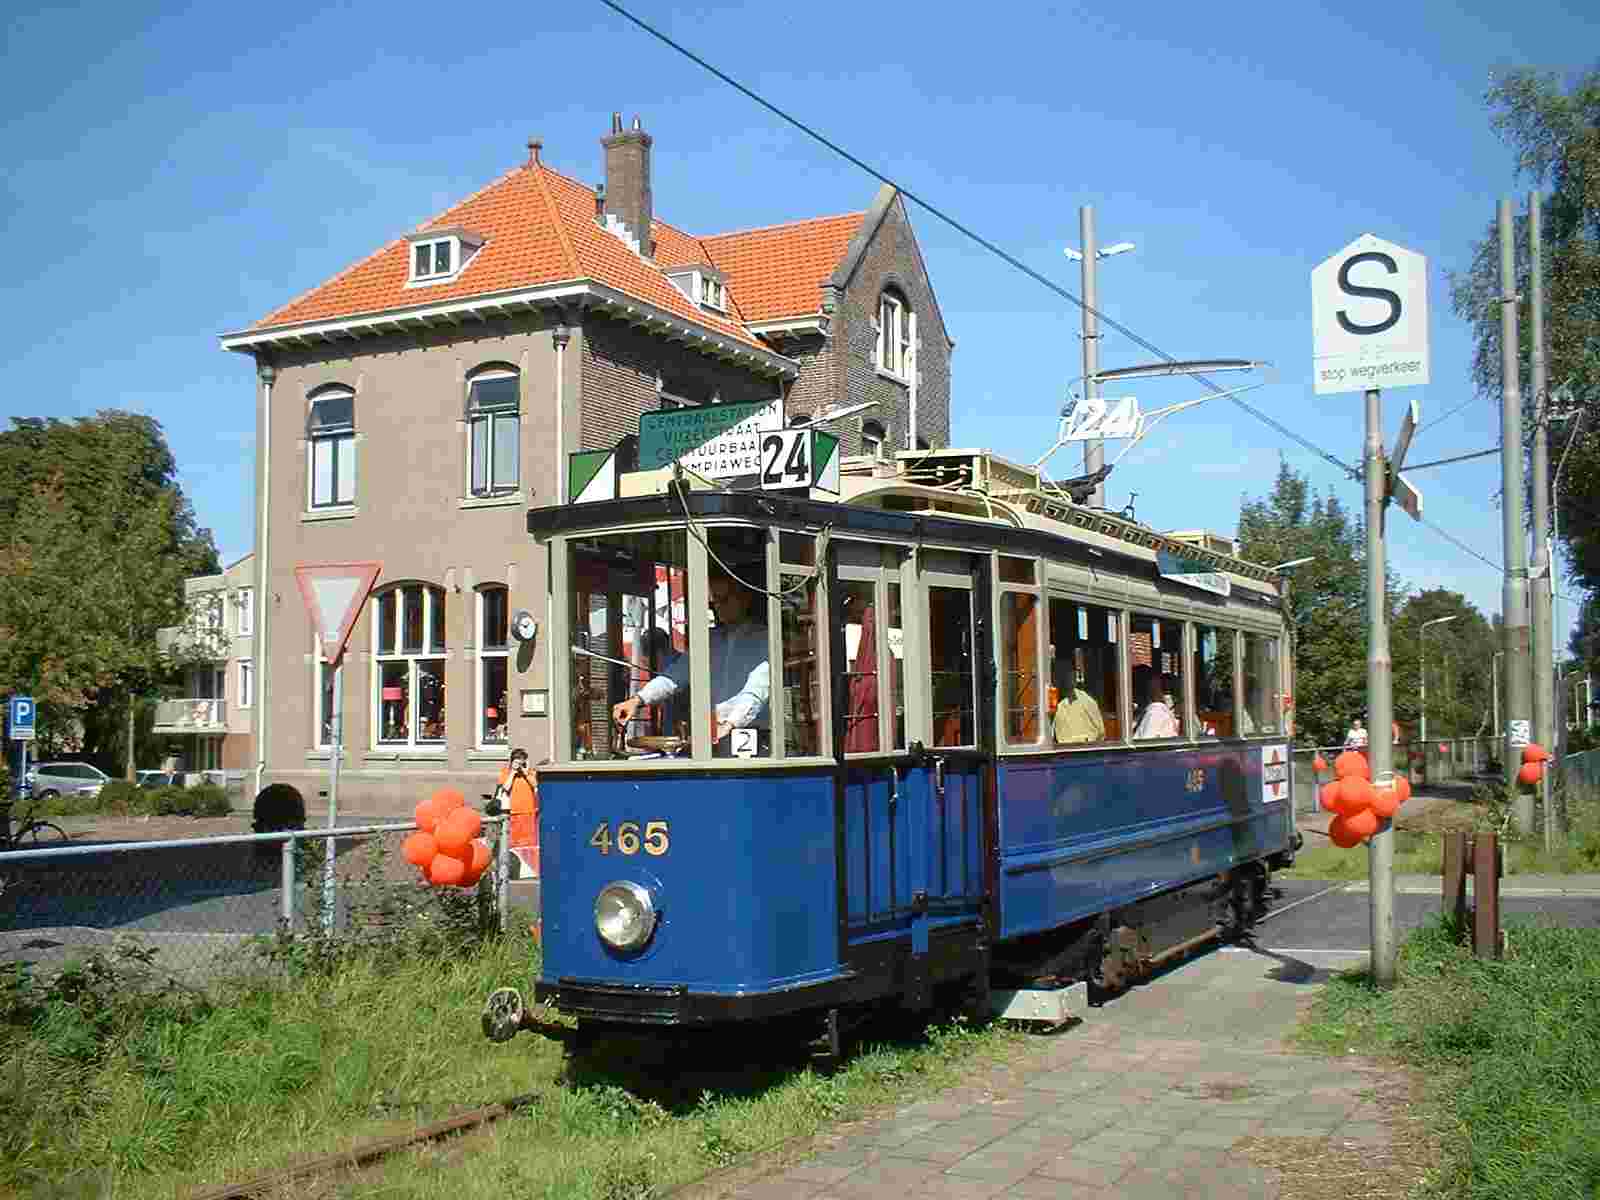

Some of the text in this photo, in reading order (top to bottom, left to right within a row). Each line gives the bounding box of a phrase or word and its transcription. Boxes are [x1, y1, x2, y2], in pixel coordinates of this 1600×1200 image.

[1336, 251, 1402, 335] S
[1320, 360, 1421, 384] stop wegverkeer
[762, 432, 809, 484] 24
[16, 701, 31, 725] P
[737, 731, 753, 753] 2
[591, 821, 670, 857] 465
